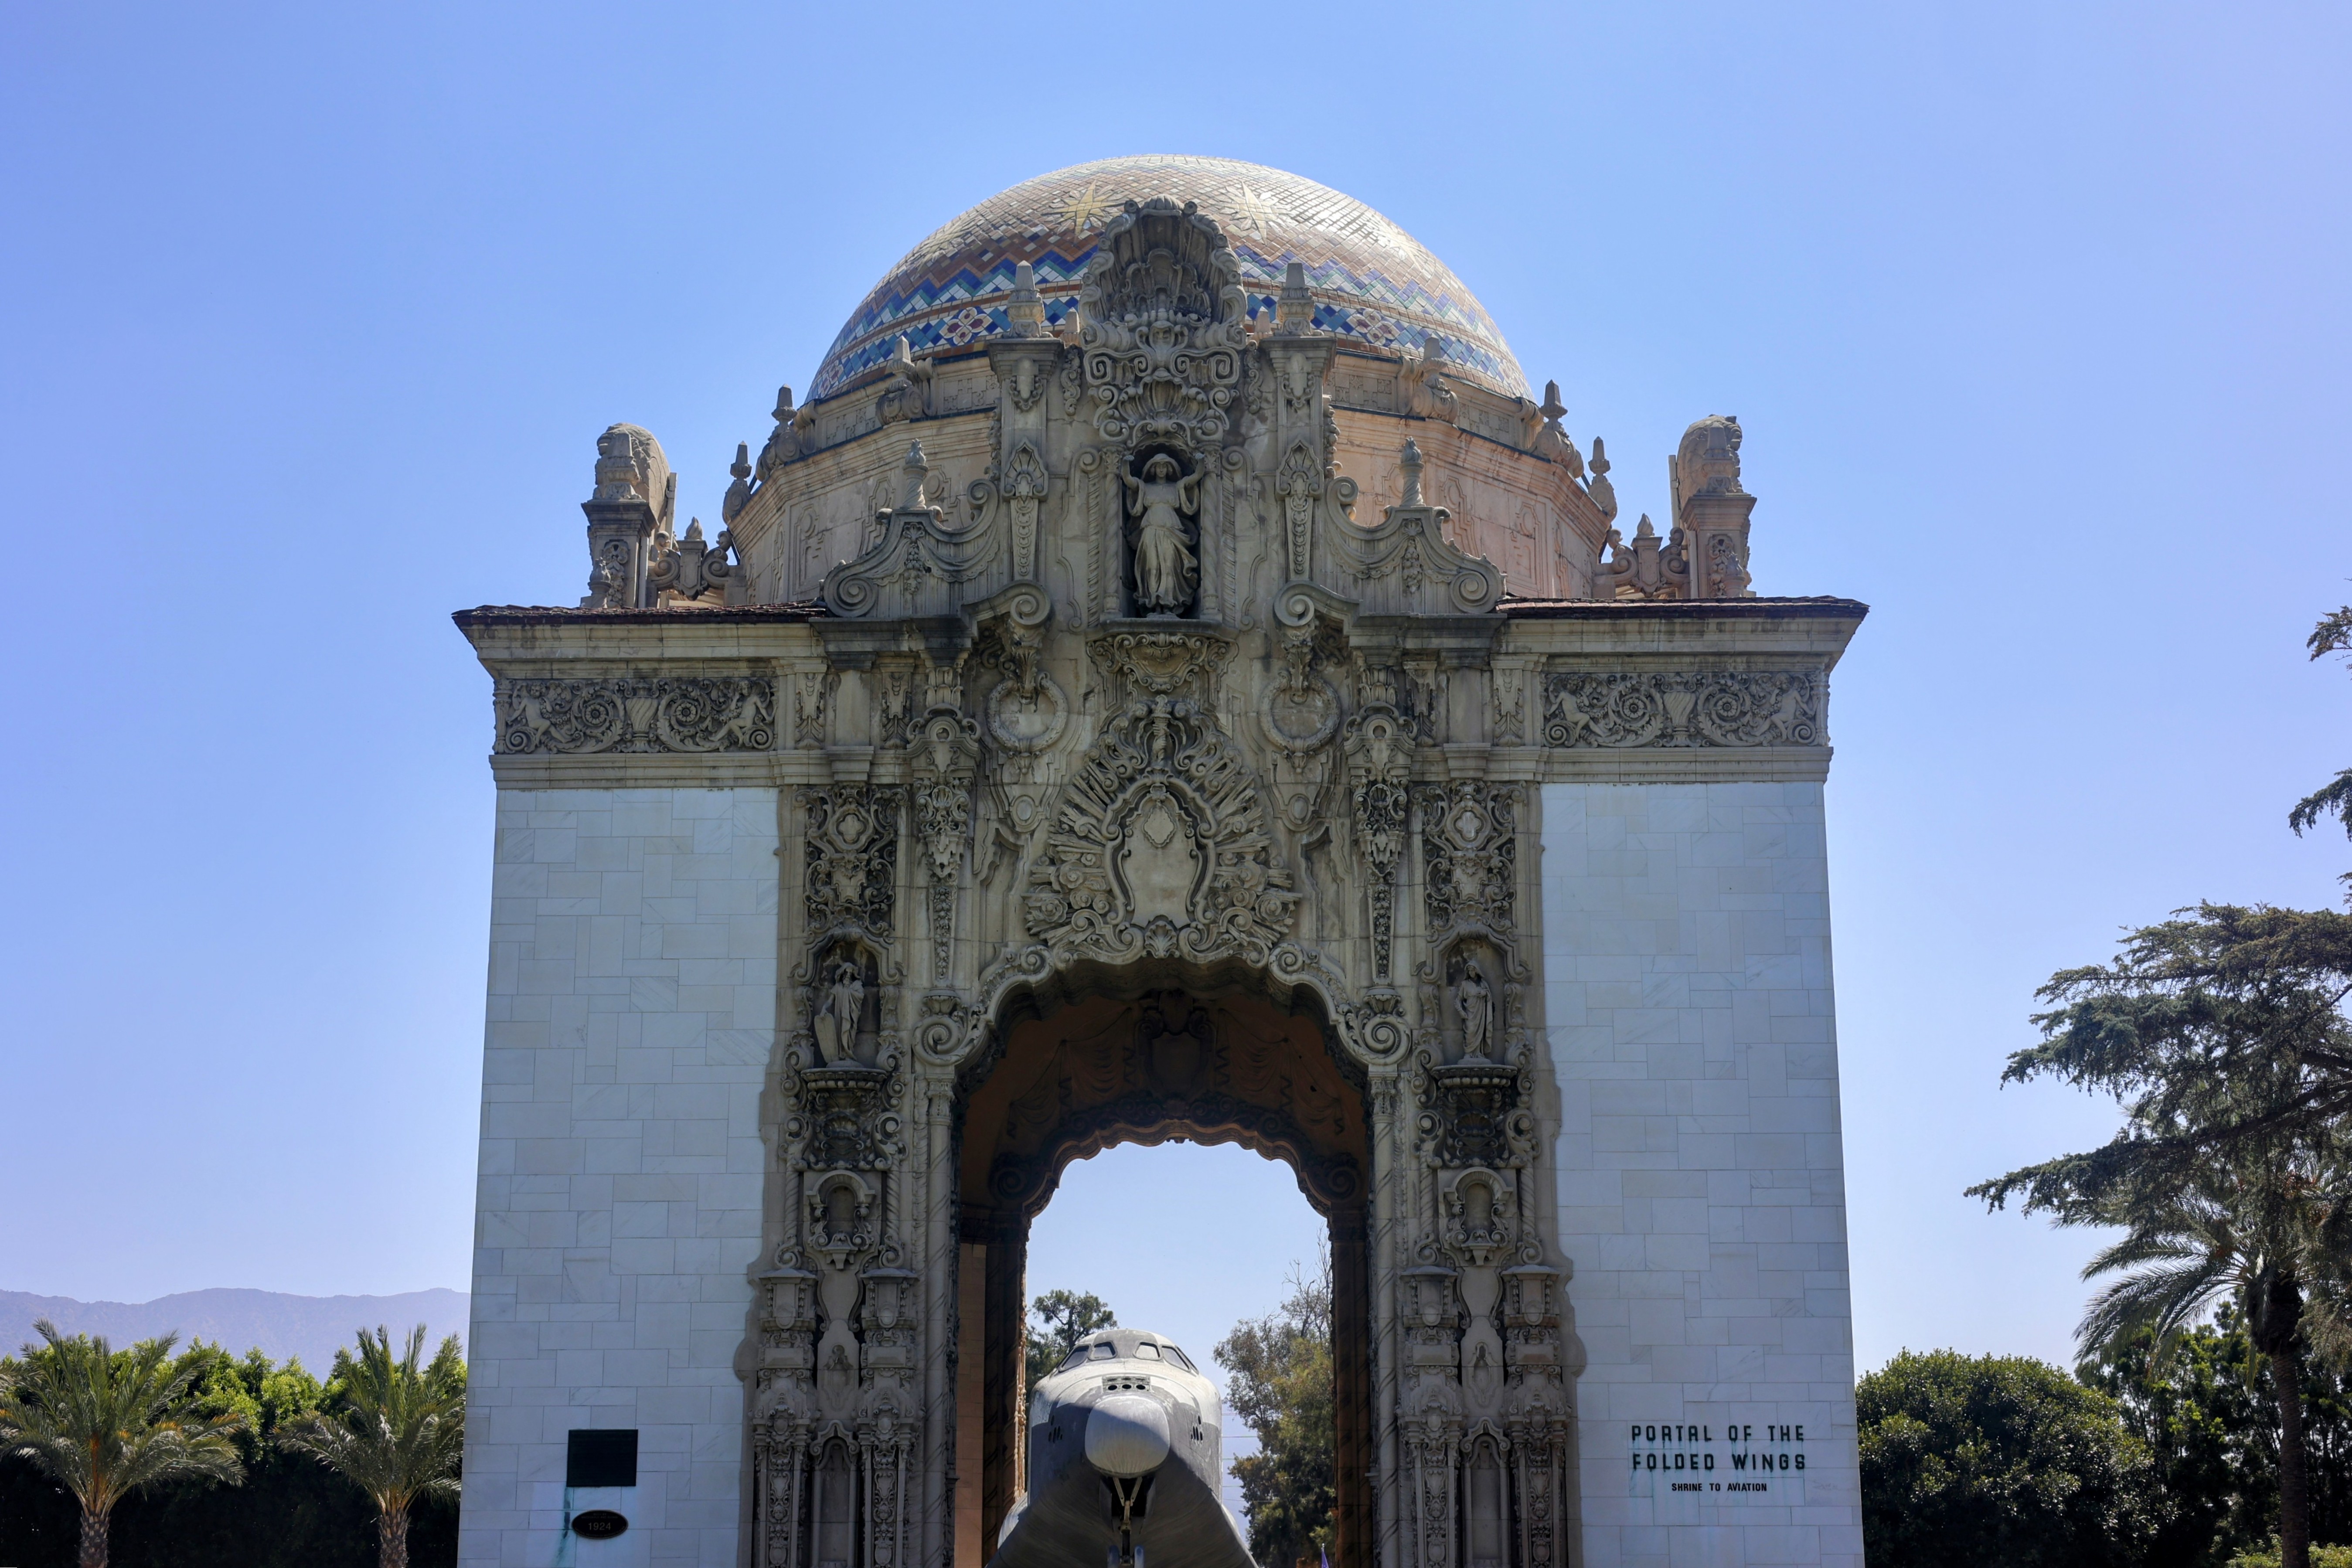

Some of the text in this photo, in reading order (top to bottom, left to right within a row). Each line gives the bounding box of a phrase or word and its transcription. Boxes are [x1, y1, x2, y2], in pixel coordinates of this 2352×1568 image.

[1632, 1425, 1804, 1442] PORTAL OF THE
[1633, 1453, 1805, 1470] FOLDED WINGS
[1671, 1483, 1767, 1491] SHRINE TO AVIATION
[588, 1522, 611, 1531] 1924
